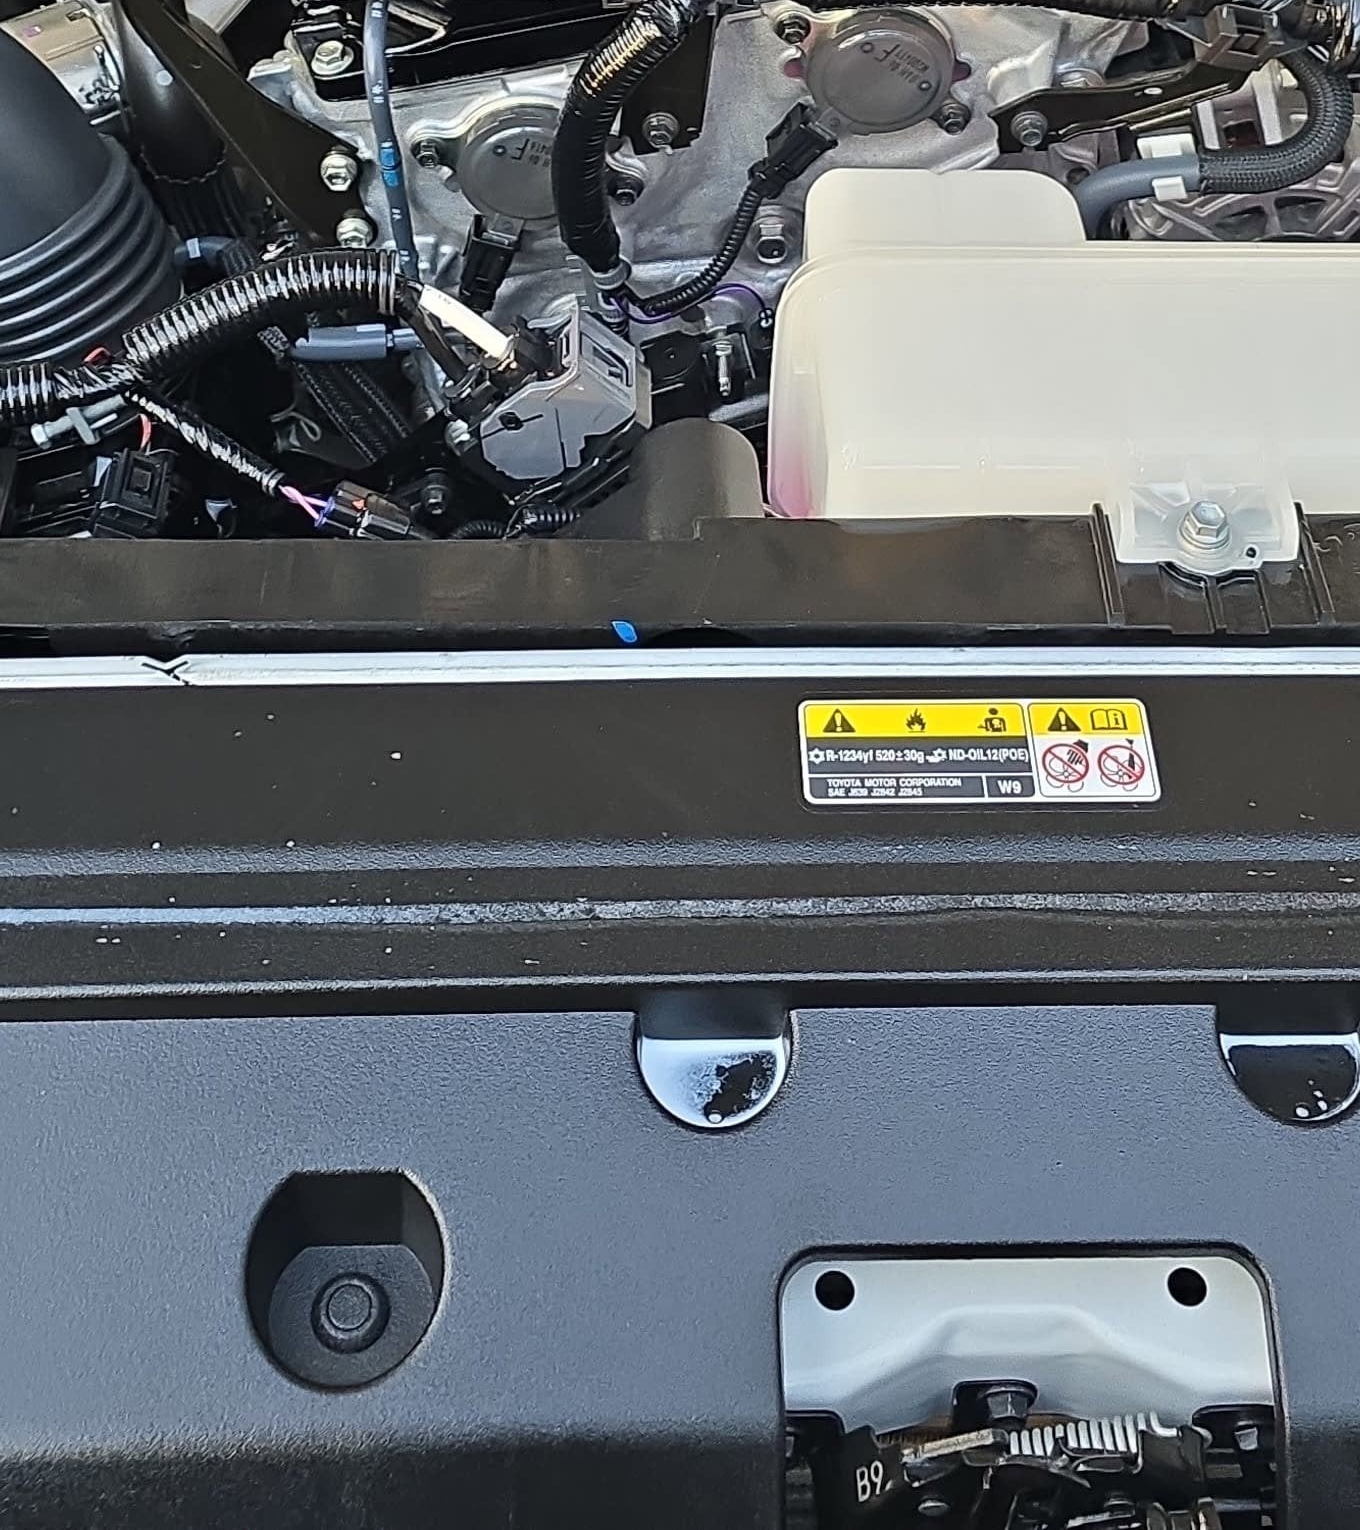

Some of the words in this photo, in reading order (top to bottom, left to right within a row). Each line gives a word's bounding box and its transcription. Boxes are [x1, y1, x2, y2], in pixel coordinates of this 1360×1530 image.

[827, 778, 862, 788] TOYOTA
[864, 778, 897, 787] MOTOR
[898, 777, 962, 787] CORPORATION
[997, 779, 1022, 795] W9
